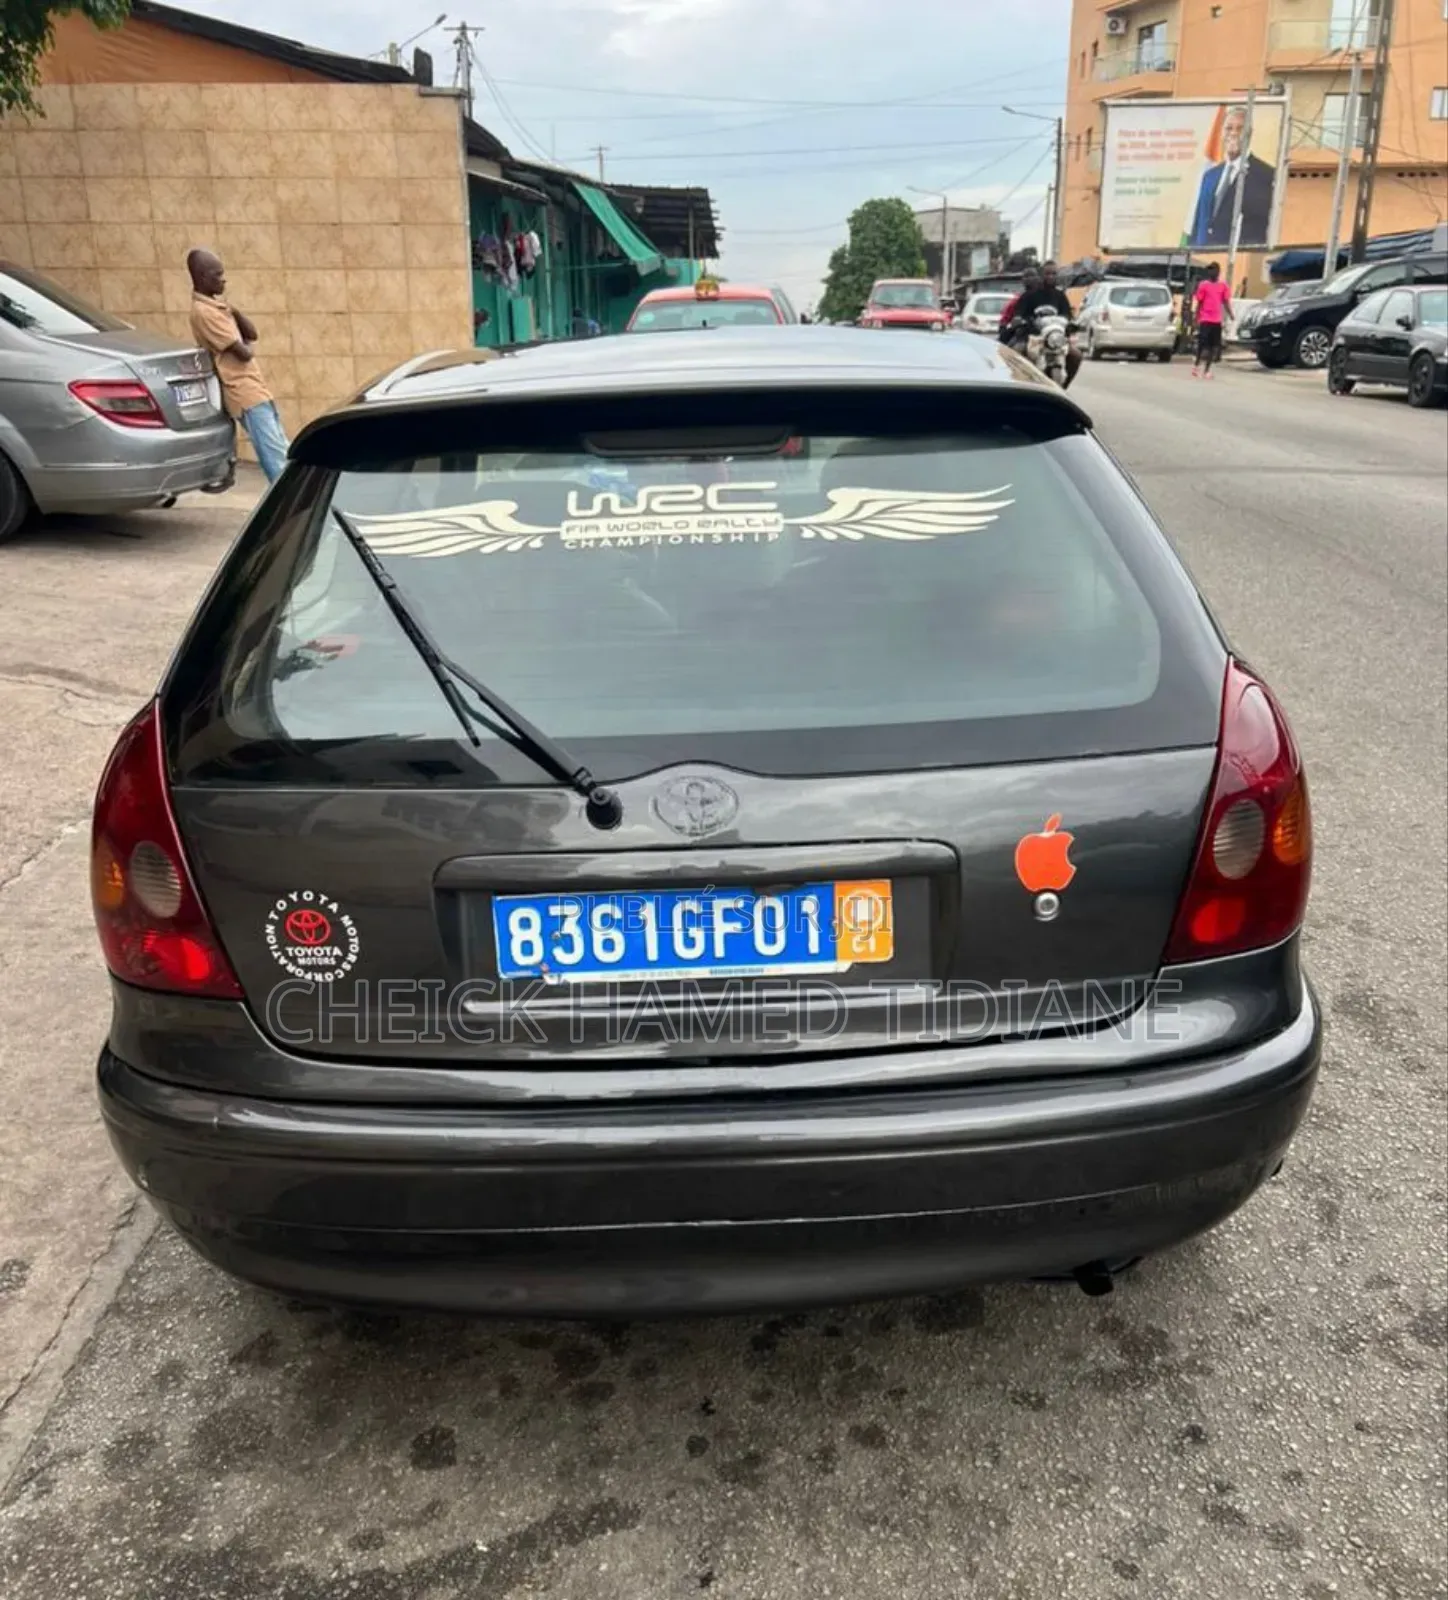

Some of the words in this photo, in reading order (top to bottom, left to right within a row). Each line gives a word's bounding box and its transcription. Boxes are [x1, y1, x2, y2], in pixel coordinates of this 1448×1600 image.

[567, 481, 778, 517] WRC
[563, 531, 779, 550] CHAMPIONSHIP
[565, 523, 601, 536] FIA
[606, 518, 690, 534] WORLD
[268, 890, 339, 921] TOYOTA
[340, 914, 360, 971] MOTORS
[508, 894, 820, 966] 8361GF01
[265, 923, 345, 982] CORPORATION
[285, 945, 343, 957] TOYOTA
[297, 956, 337, 966] MOTORS
